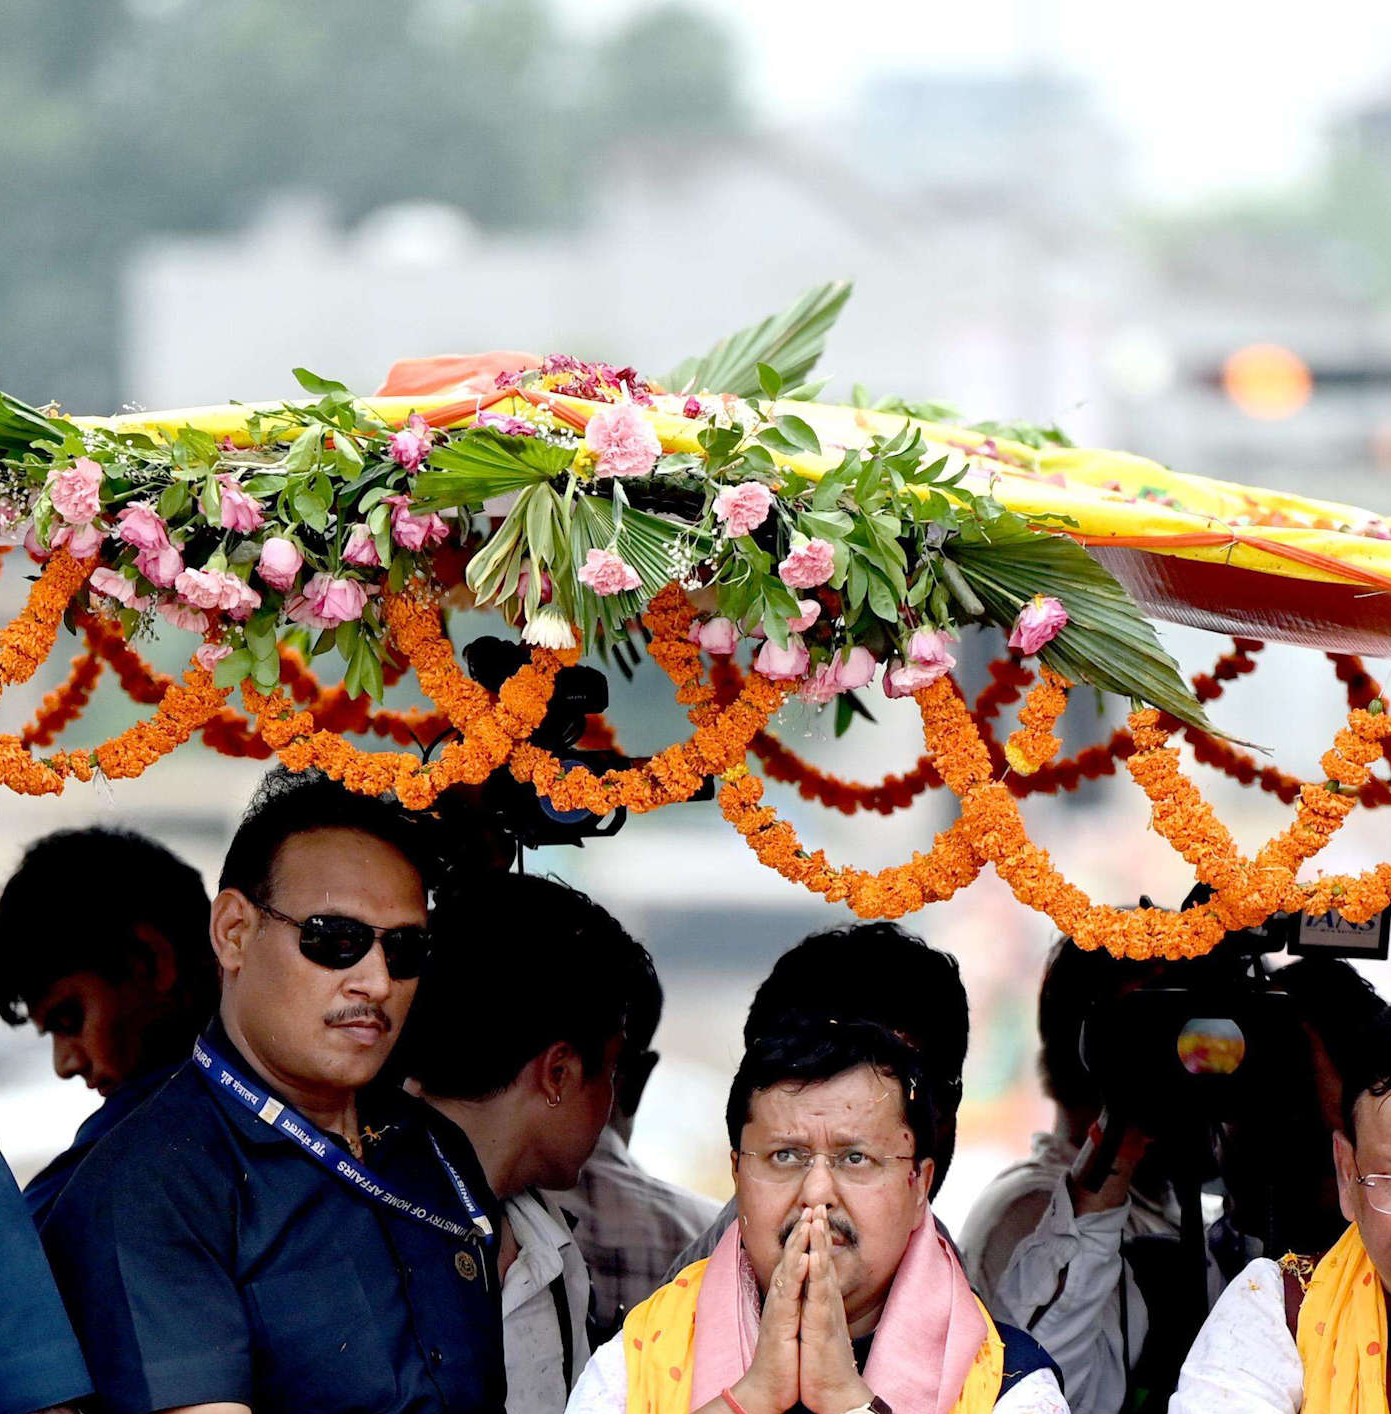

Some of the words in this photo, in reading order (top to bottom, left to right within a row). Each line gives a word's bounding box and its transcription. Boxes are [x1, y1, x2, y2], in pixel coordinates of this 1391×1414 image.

[336, 1160, 383, 1197] AFFAIRS
[381, 1193, 412, 1214] HOME
[410, 1204, 427, 1220] OF
